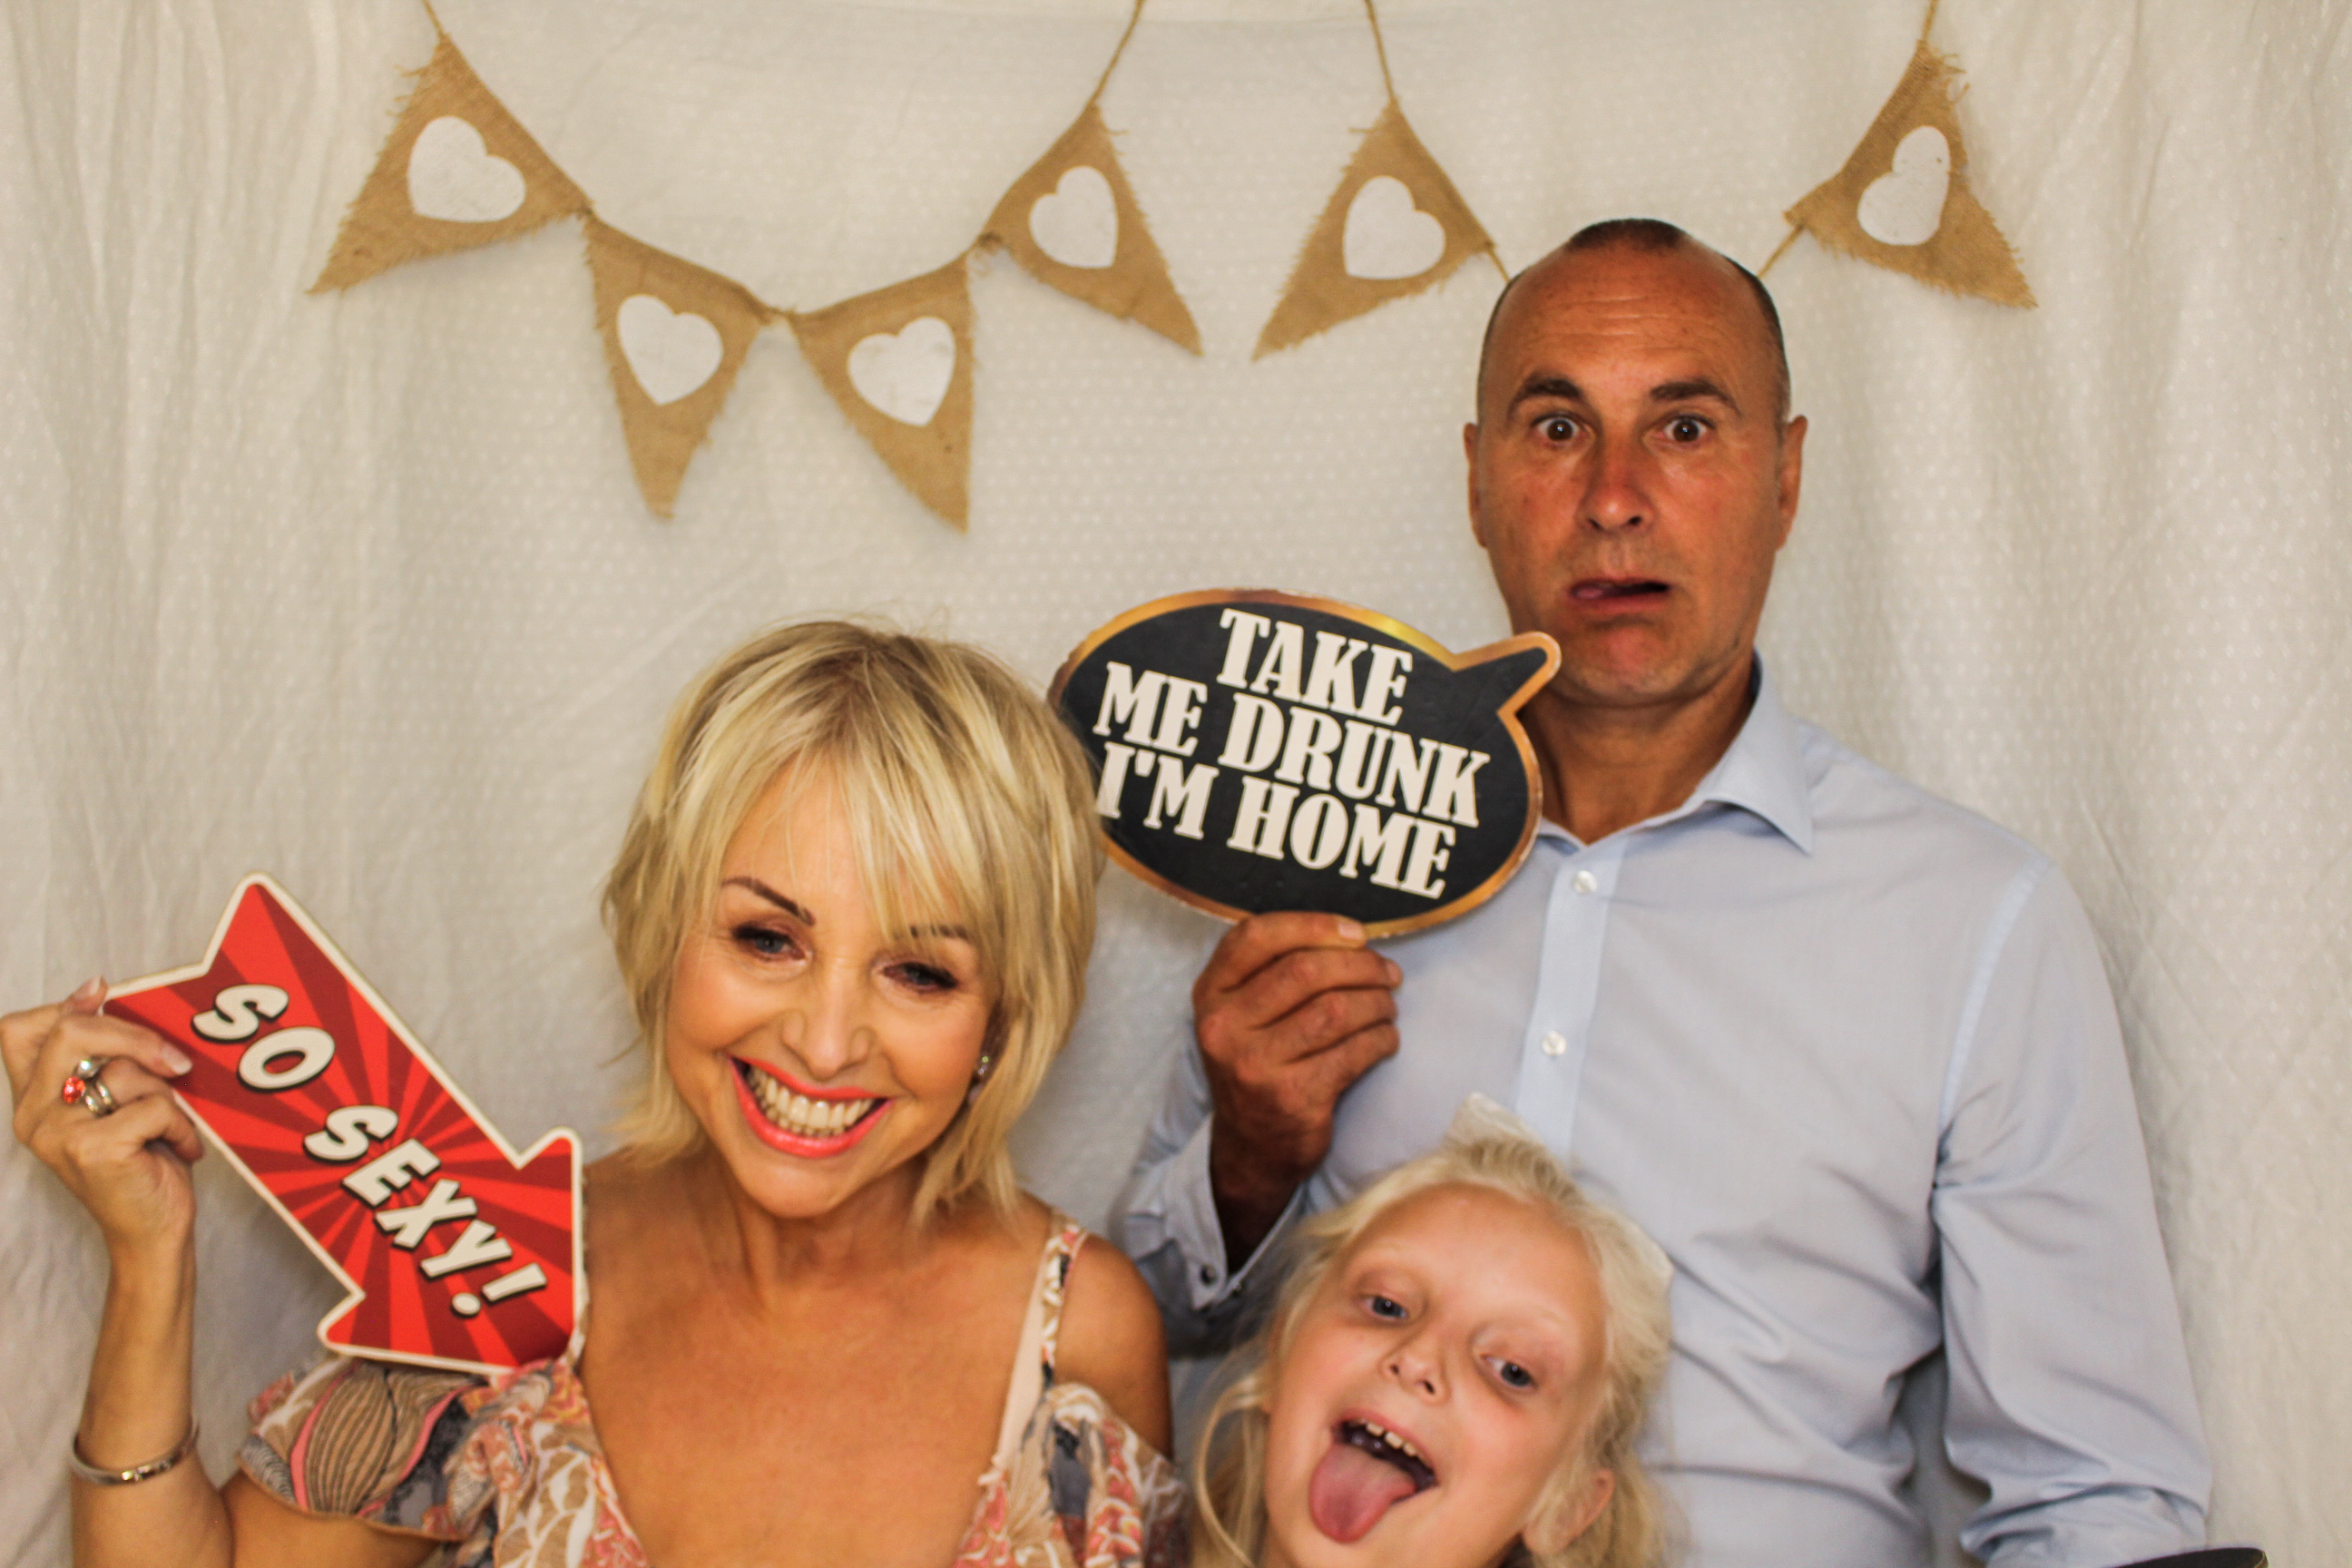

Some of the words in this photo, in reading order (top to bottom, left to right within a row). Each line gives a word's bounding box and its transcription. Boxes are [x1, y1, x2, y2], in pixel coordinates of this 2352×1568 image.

[1093, 661, 1208, 757] ME
[1218, 692, 1490, 828] DRUNK
[1217, 608, 1413, 726] TAKE
[1095, 741, 1219, 839] I'M
[1227, 776, 1455, 899] HOME
[191, 984, 336, 1093] SO
[302, 1105, 548, 1318] SEXY!
